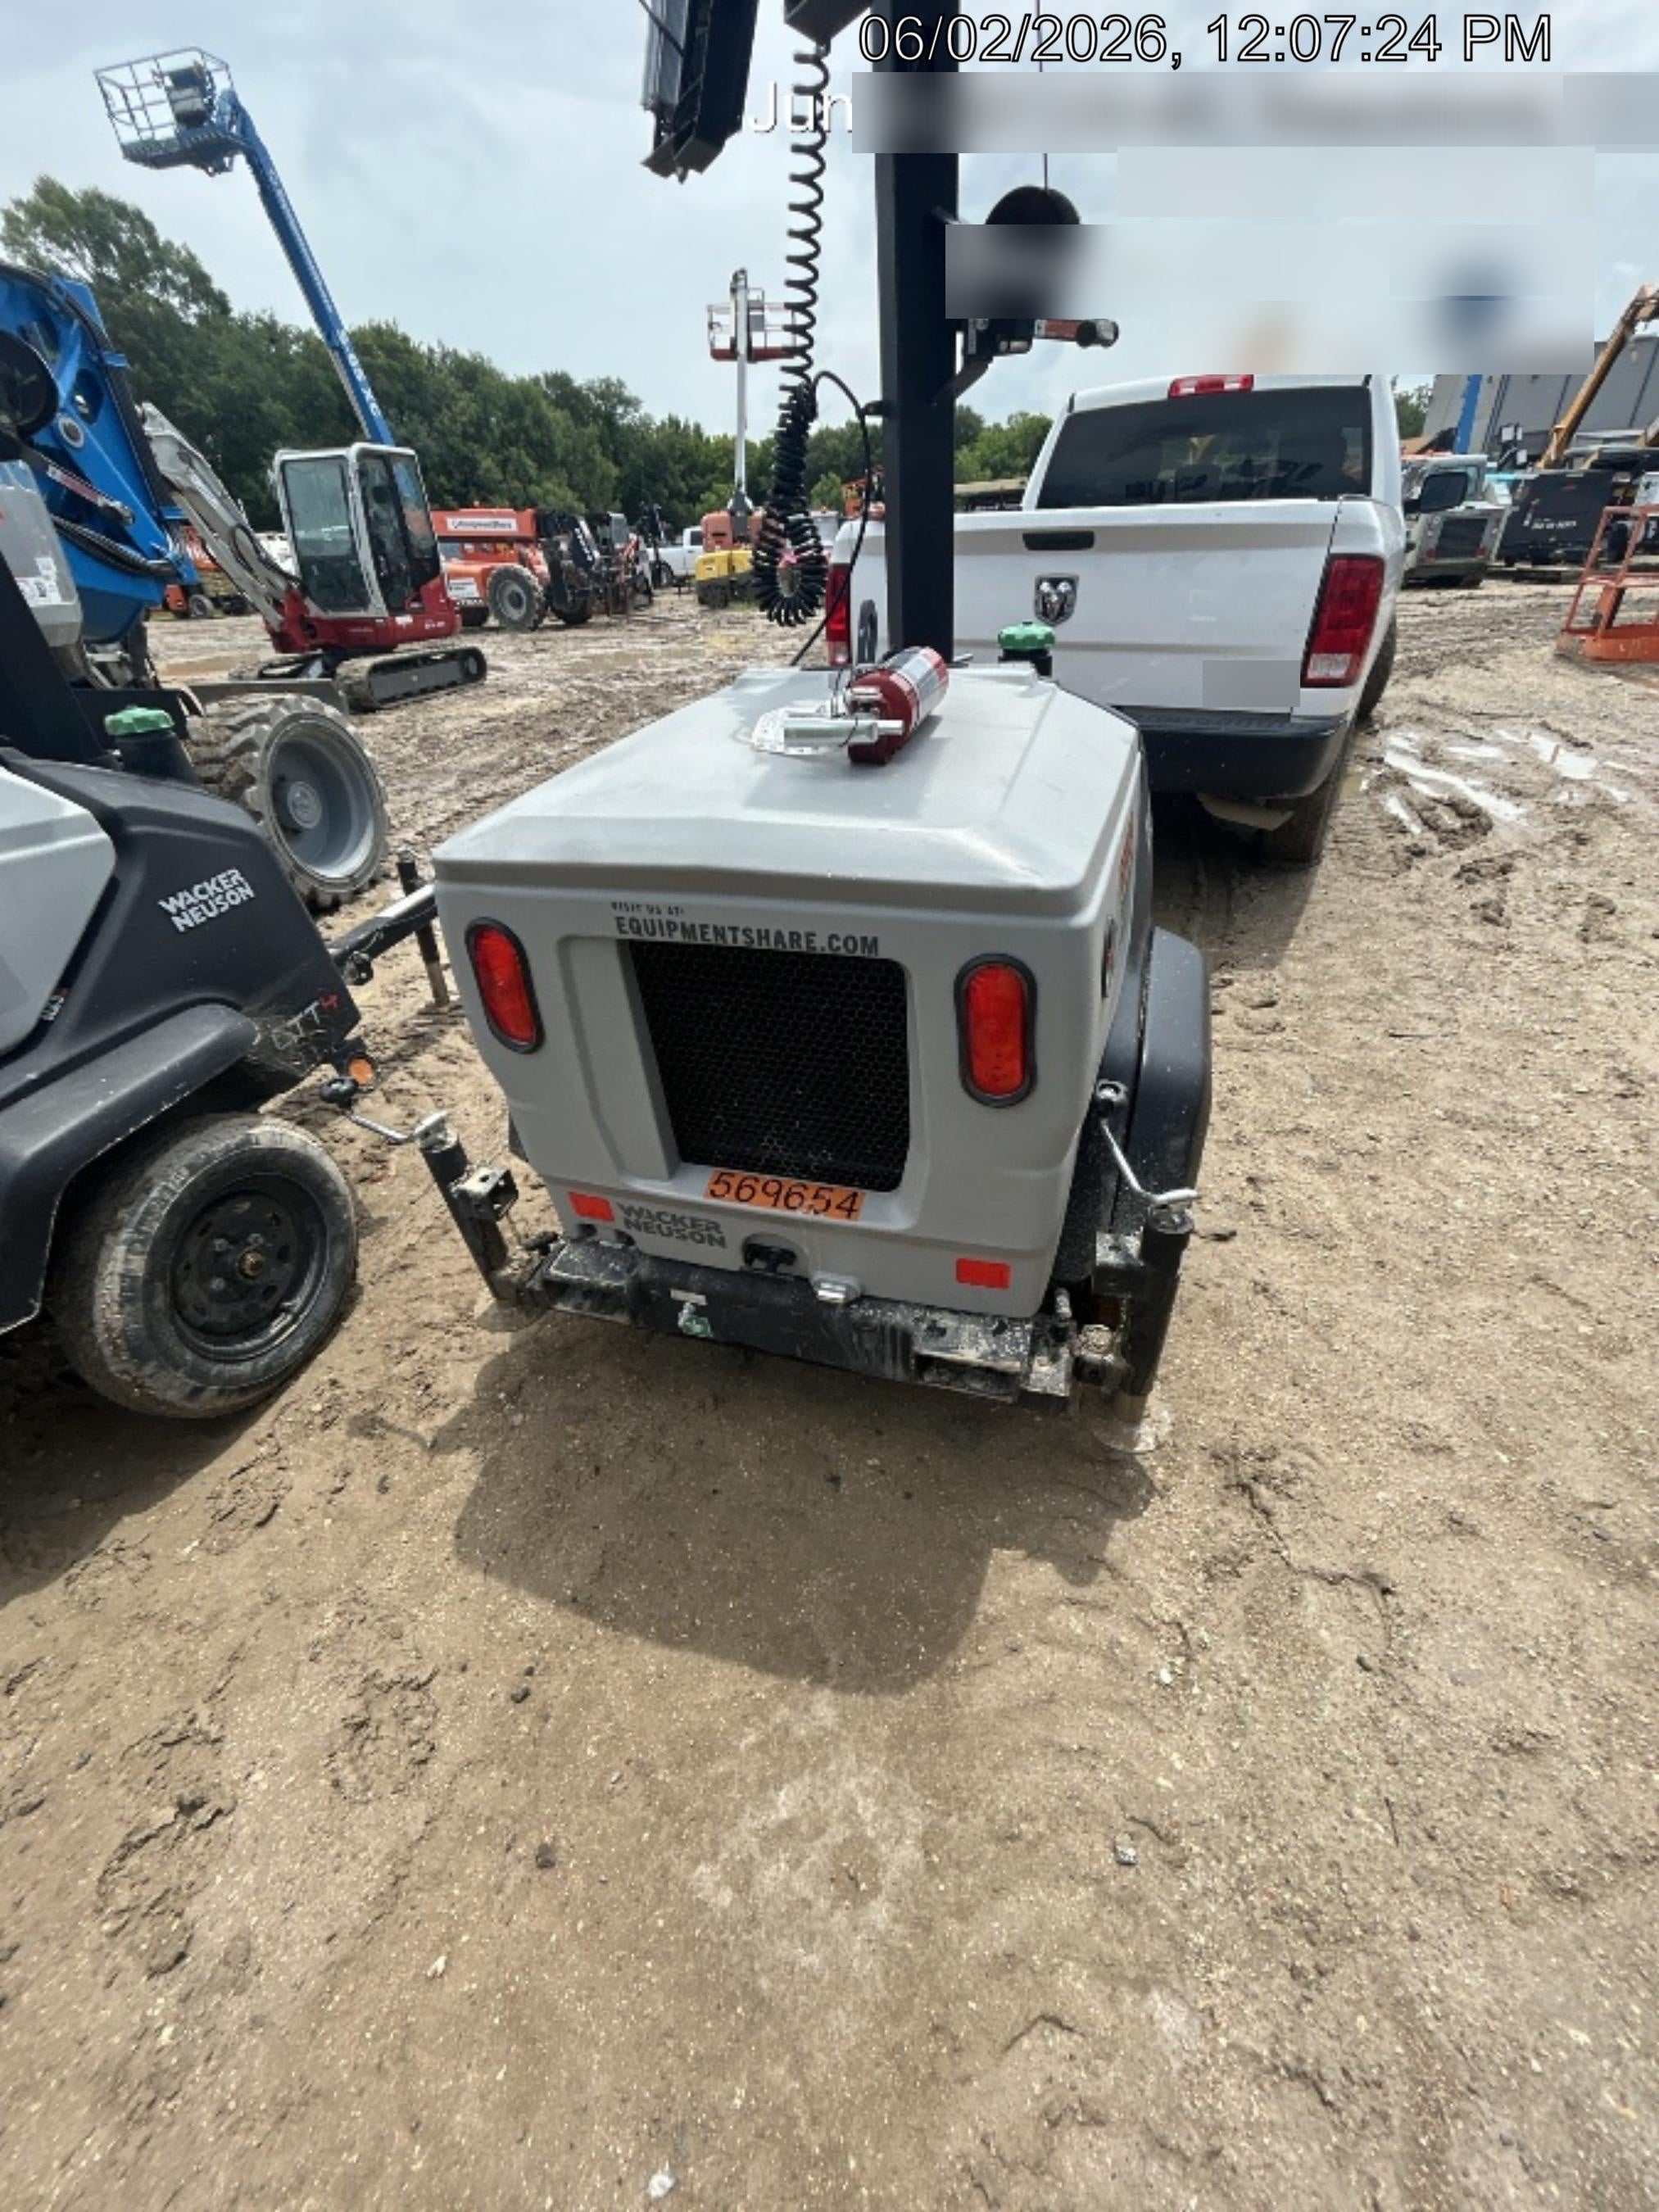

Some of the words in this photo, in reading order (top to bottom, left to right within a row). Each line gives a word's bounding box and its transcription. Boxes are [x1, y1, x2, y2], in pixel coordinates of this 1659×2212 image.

[157, 868, 245, 914] WACKER
[170, 882, 255, 931] NEUSON
[615, 916, 879, 956] EQUIPMENTSHARE.COM
[709, 1172, 859, 1219] 569654
[616, 1201, 723, 1235] WACKER
[623, 1217, 728, 1249] NEUSON
